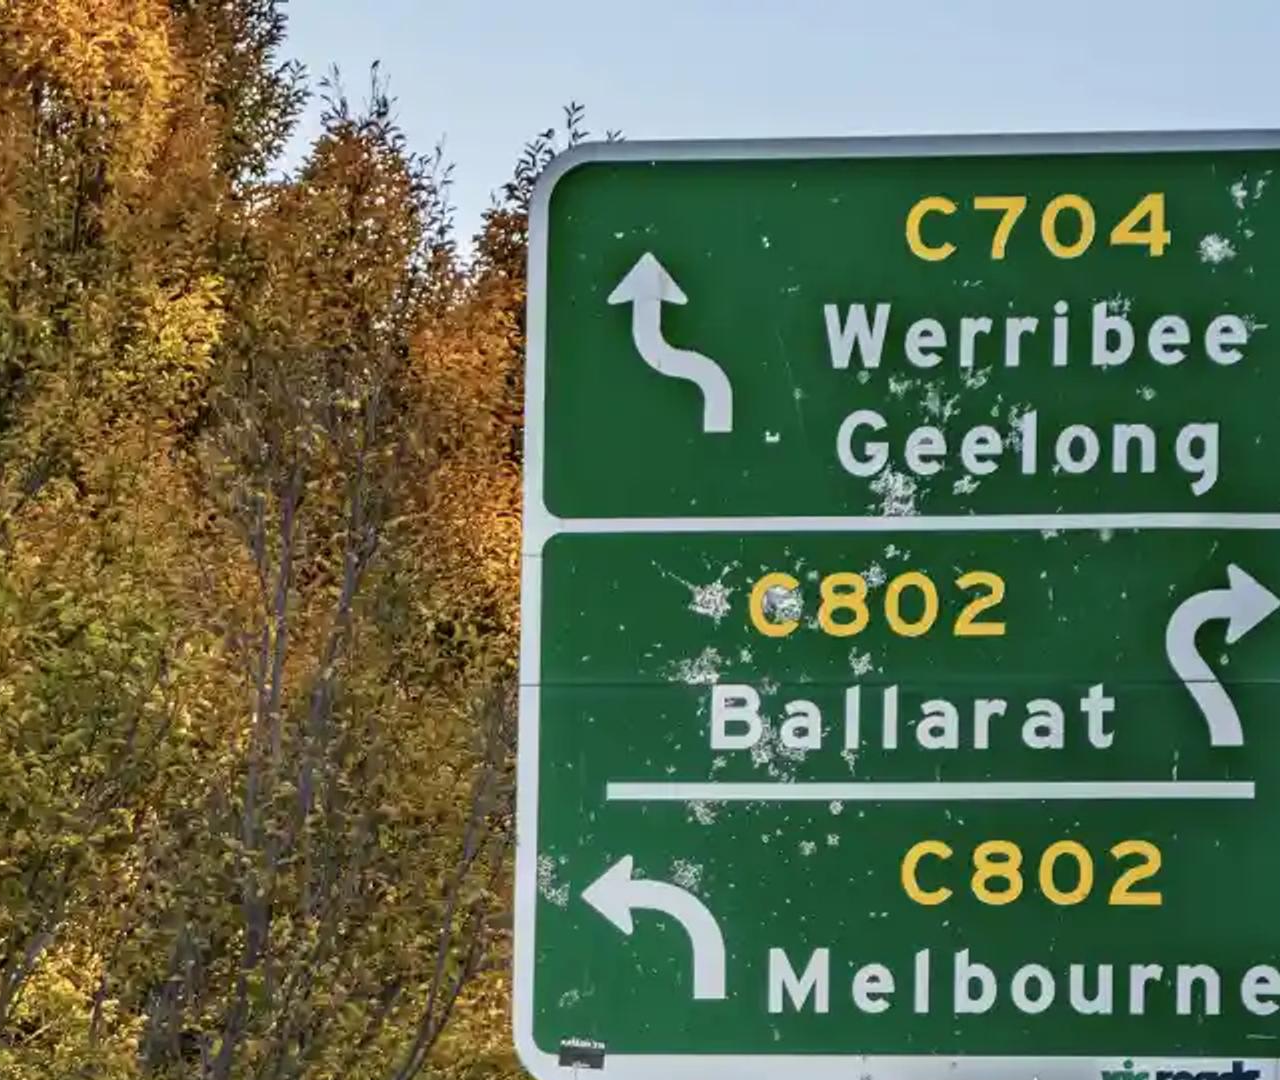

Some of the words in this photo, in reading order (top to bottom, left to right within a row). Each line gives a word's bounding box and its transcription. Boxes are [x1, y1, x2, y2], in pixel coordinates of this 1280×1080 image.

[904, 191, 1171, 262] C704
[823, 299, 1250, 370] Werribee
[836, 408, 1222, 497] Geelong
[746, 570, 1009, 638] C802
[710, 683, 1116, 751] Ballarat
[900, 839, 1164, 907] C802
